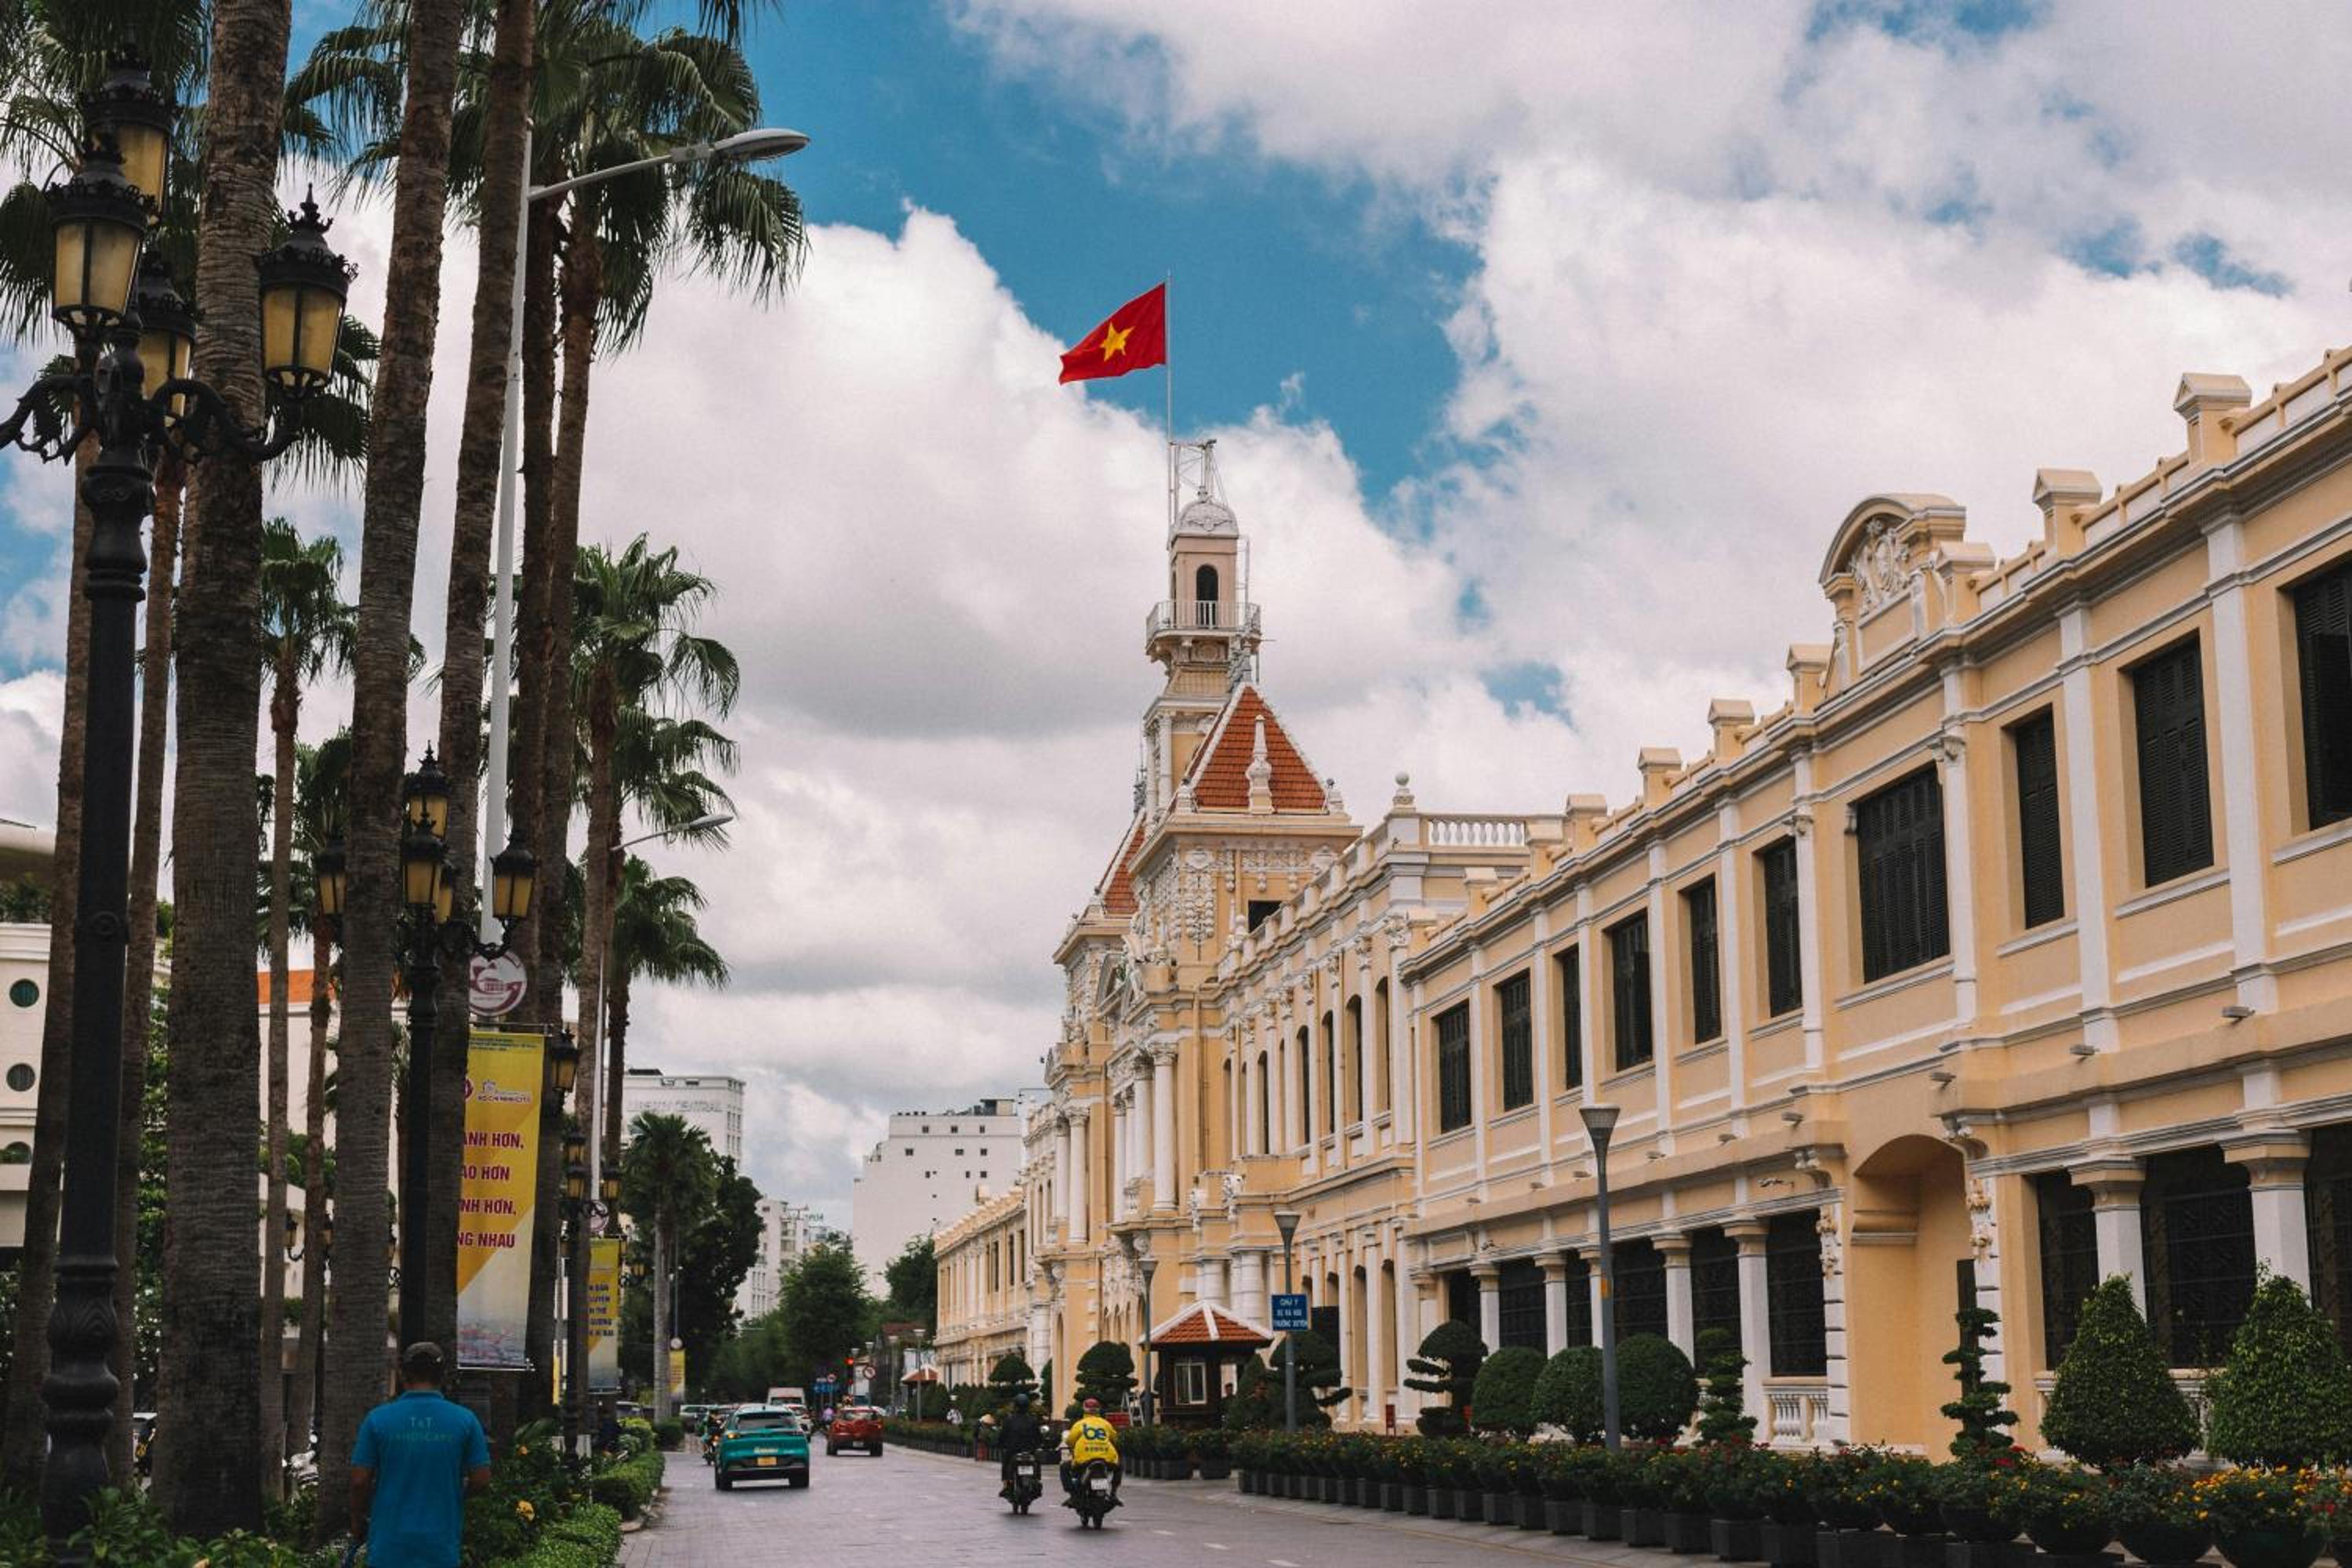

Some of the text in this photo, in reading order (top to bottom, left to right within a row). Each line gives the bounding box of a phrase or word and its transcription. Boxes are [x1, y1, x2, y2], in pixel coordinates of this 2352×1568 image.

[481, 1165, 510, 1181] HƠN
[477, 1232, 515, 1247] NHAU
[1083, 1423, 1106, 1440] be
